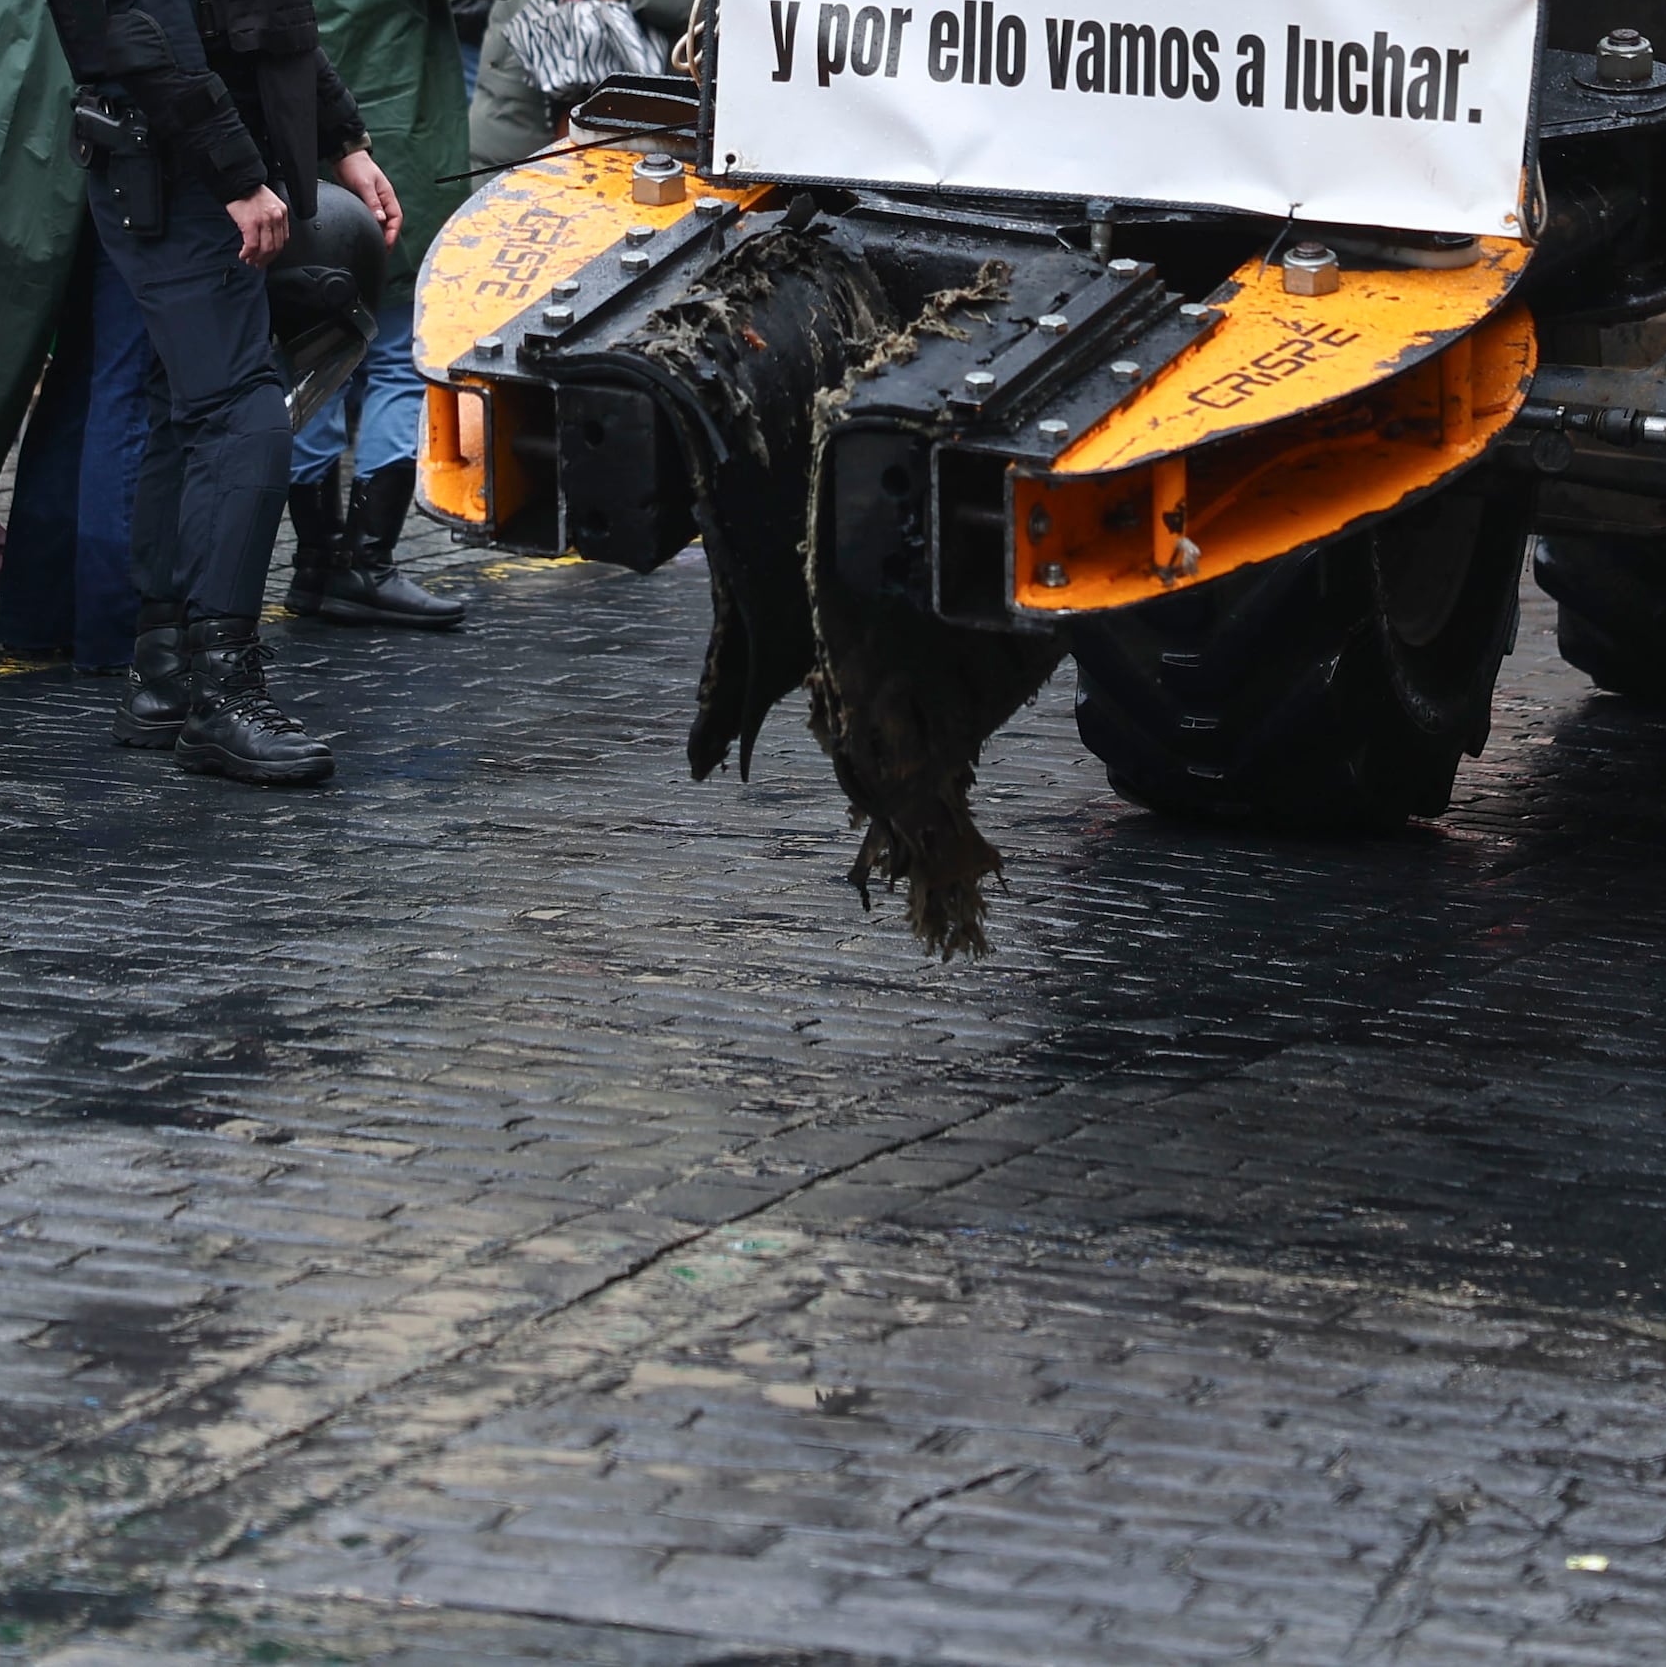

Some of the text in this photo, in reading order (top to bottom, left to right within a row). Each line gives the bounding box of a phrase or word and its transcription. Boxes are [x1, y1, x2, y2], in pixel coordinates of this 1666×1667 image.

[770, 0, 1482, 124] y por ello vamos a luchar.
